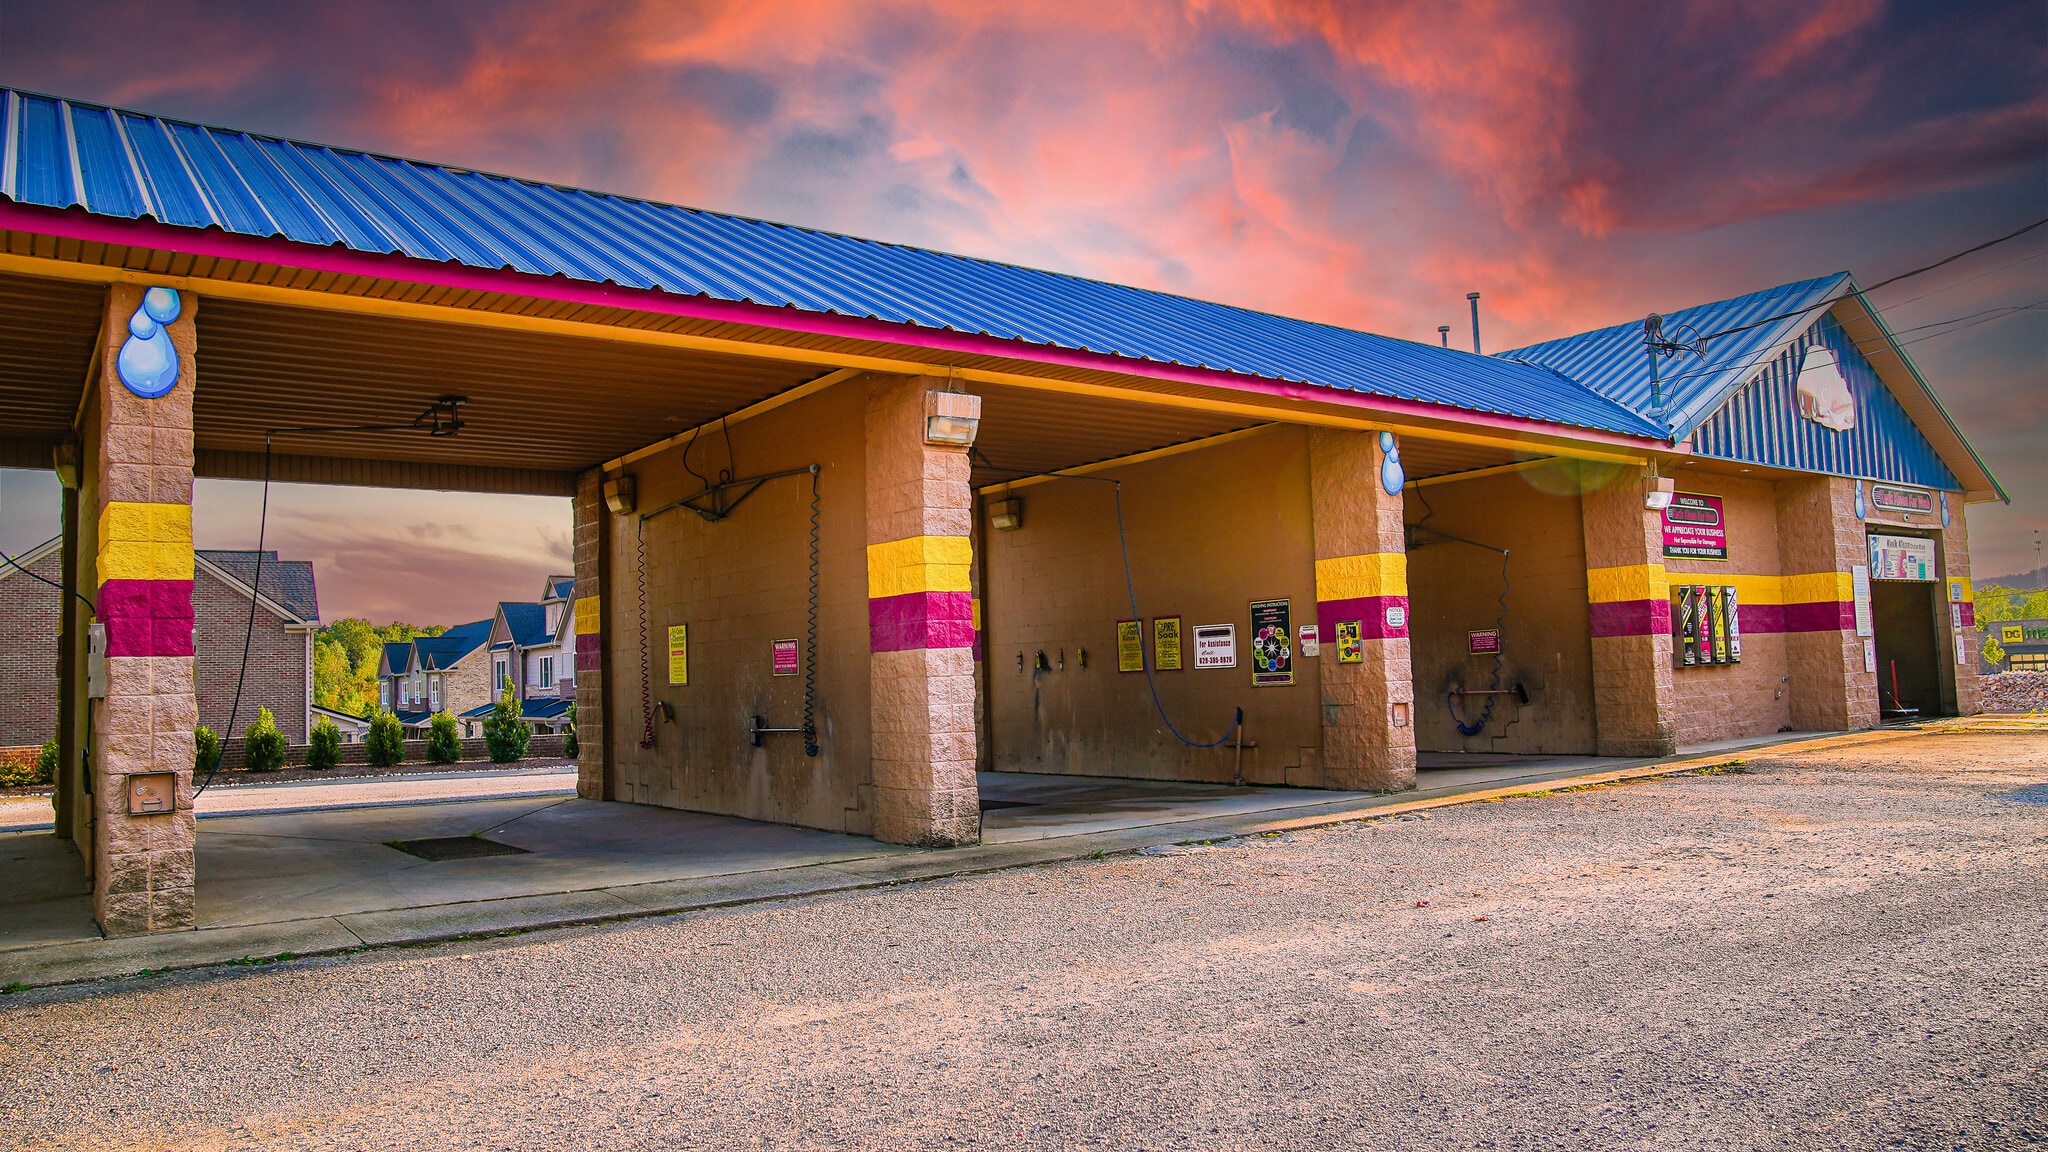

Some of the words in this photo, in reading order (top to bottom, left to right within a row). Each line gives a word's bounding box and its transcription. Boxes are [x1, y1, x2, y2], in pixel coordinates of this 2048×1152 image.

[1680, 497, 1698, 505] WELCOME
[1664, 525, 1671, 534] WE
[1672, 526, 1694, 535] APPRECIATE
[1695, 528, 1705, 536] YOUR
[1706, 528, 1724, 537] BUSINESS
[1669, 546, 1682, 554] THANK
[1707, 548, 1721, 556] BUSINESS
[1163, 622, 1175, 631] PRE
[1158, 631, 1179, 639] Soak
[2004, 630, 2020, 639] DG
[774, 642, 796, 650] WARNING
[1207, 639, 1231, 648] Assistance
